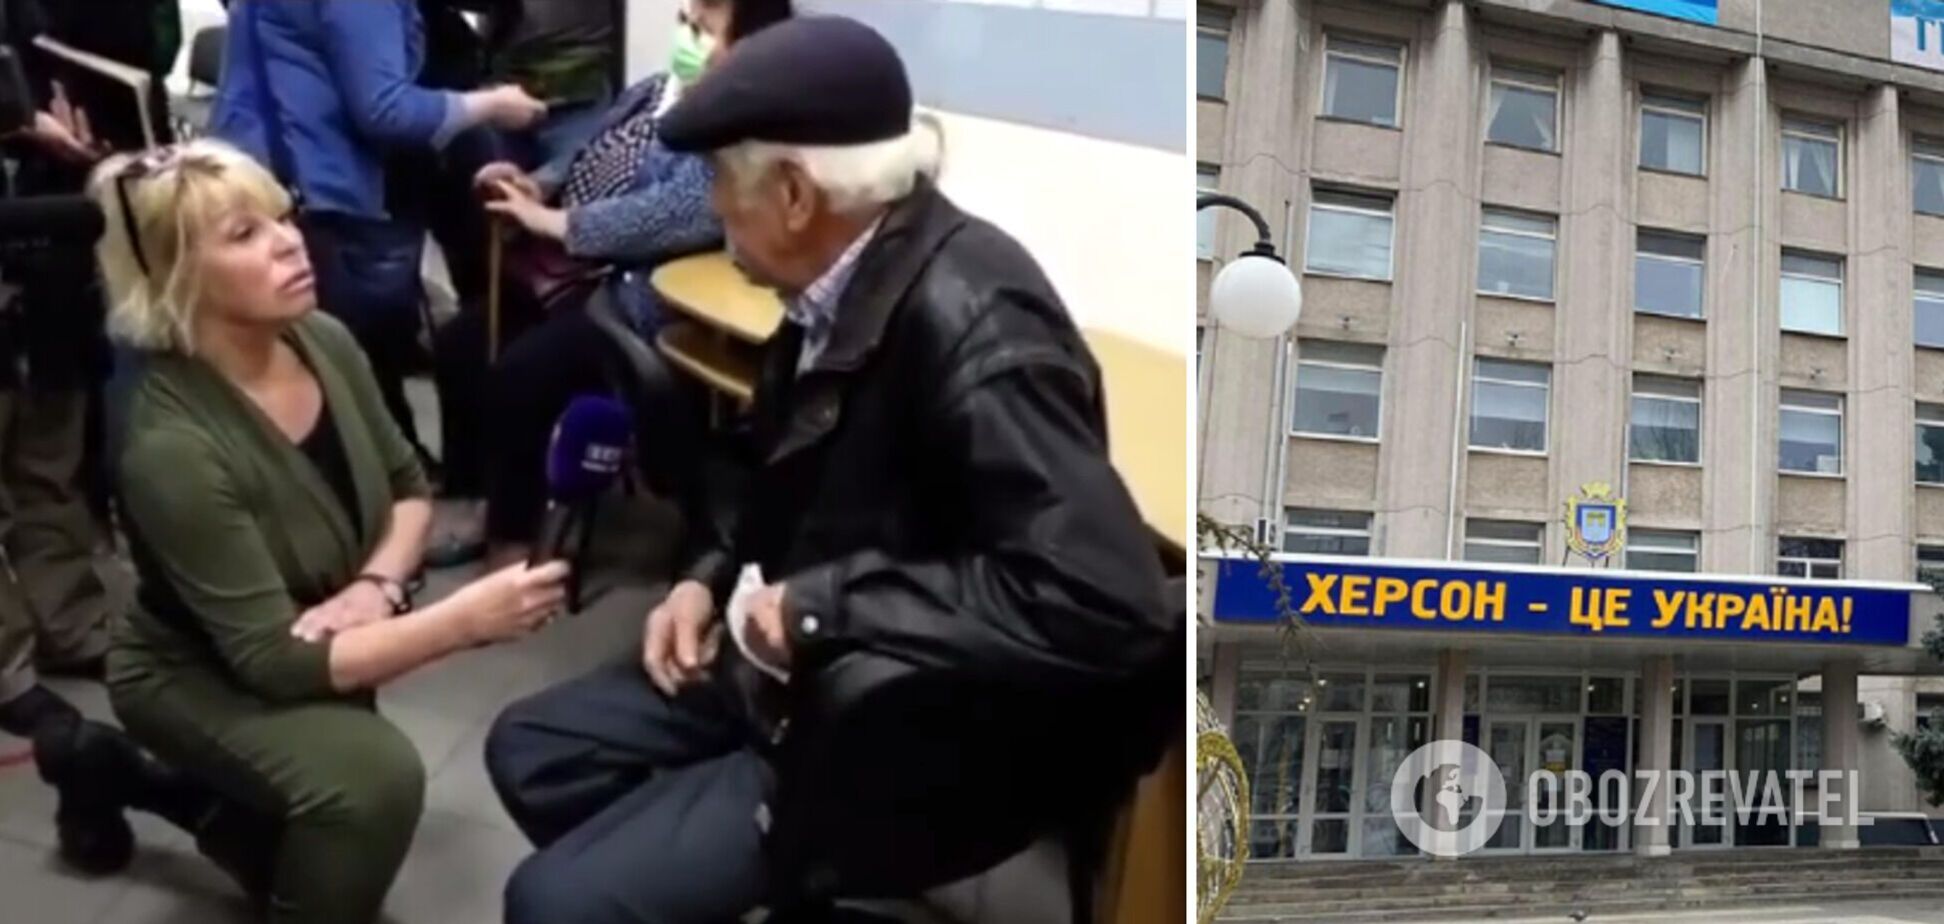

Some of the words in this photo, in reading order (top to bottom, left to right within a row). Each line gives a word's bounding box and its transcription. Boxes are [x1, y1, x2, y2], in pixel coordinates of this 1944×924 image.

[1301, 574, 1507, 620] ХЕРСОН
[1569, 587, 1632, 631] ЦЕ
[1651, 586, 1853, 633] УКРАЇНА!
